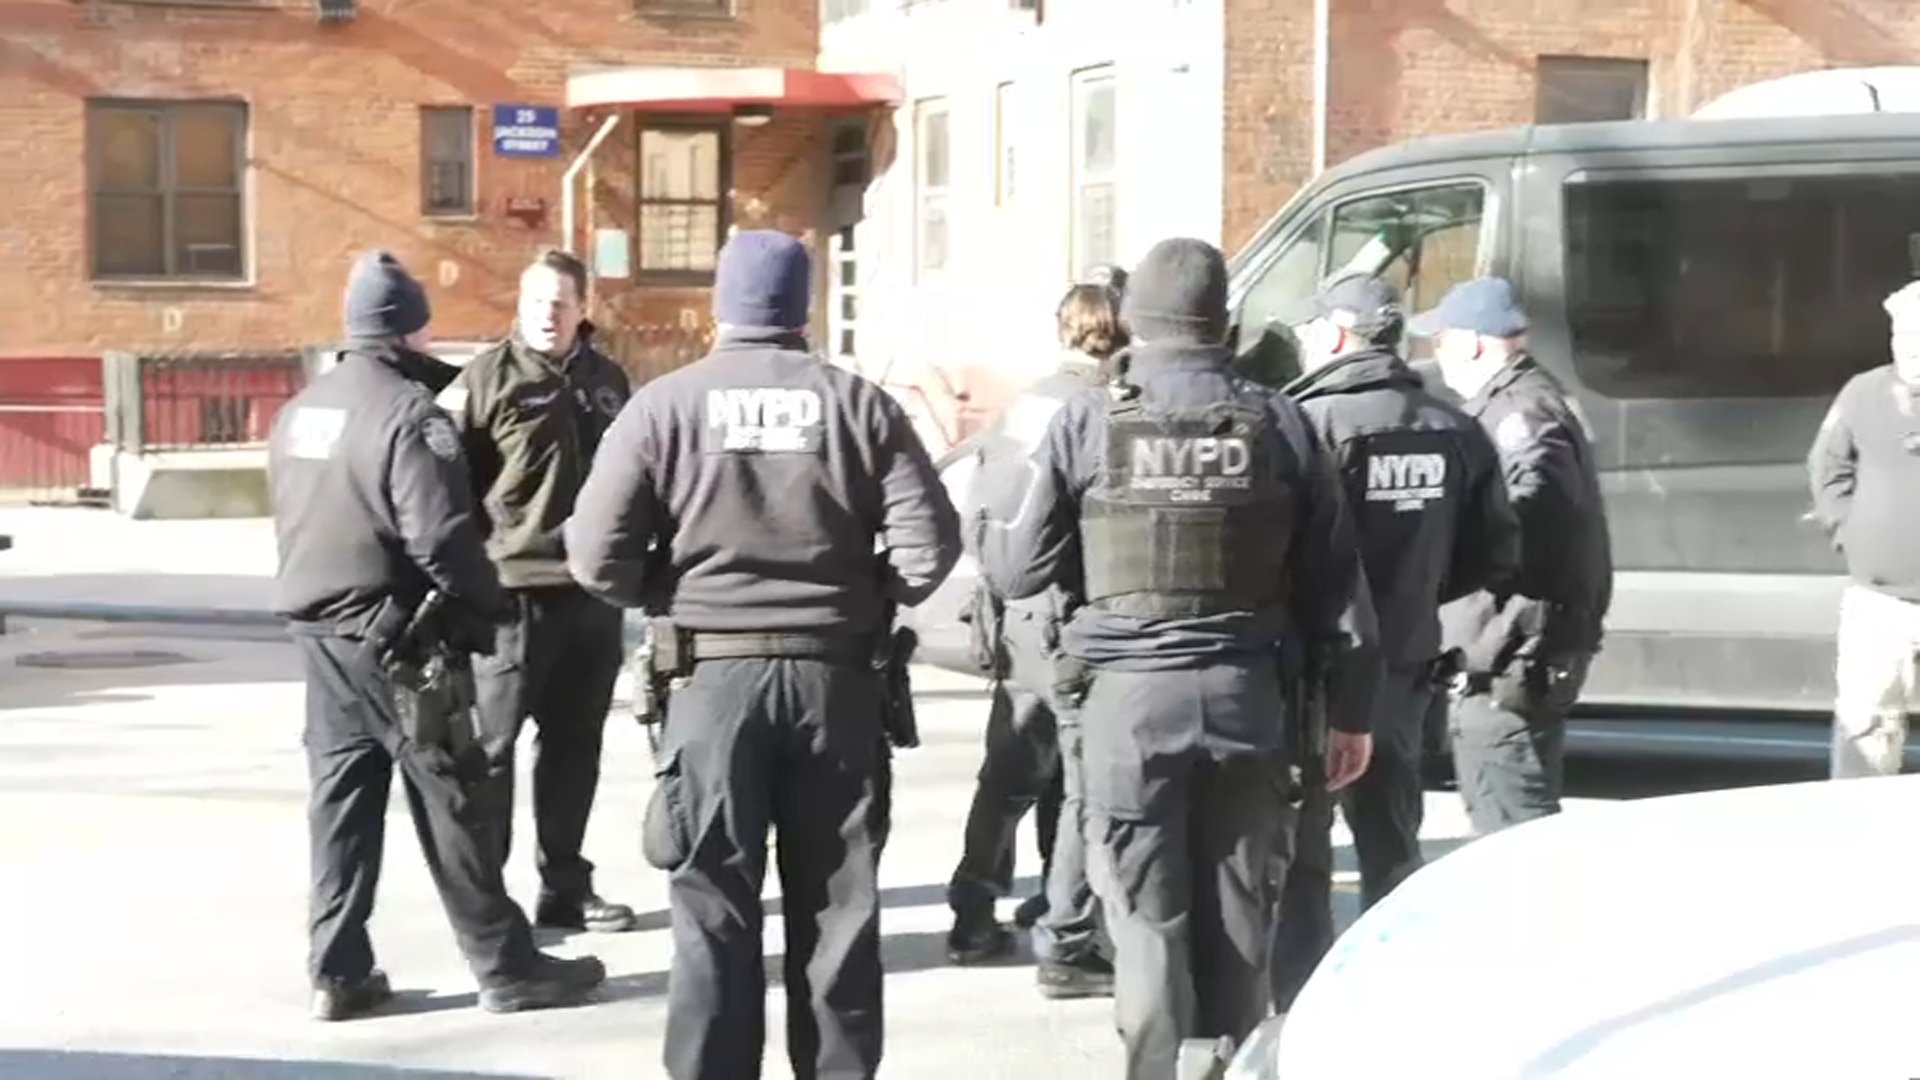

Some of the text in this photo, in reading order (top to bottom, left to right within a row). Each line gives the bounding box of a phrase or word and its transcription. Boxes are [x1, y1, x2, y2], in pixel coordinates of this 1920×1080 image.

[708, 388, 820, 428] NYPD
[1133, 437, 1250, 475] NYPD
[1367, 453, 1446, 489] NYPD
